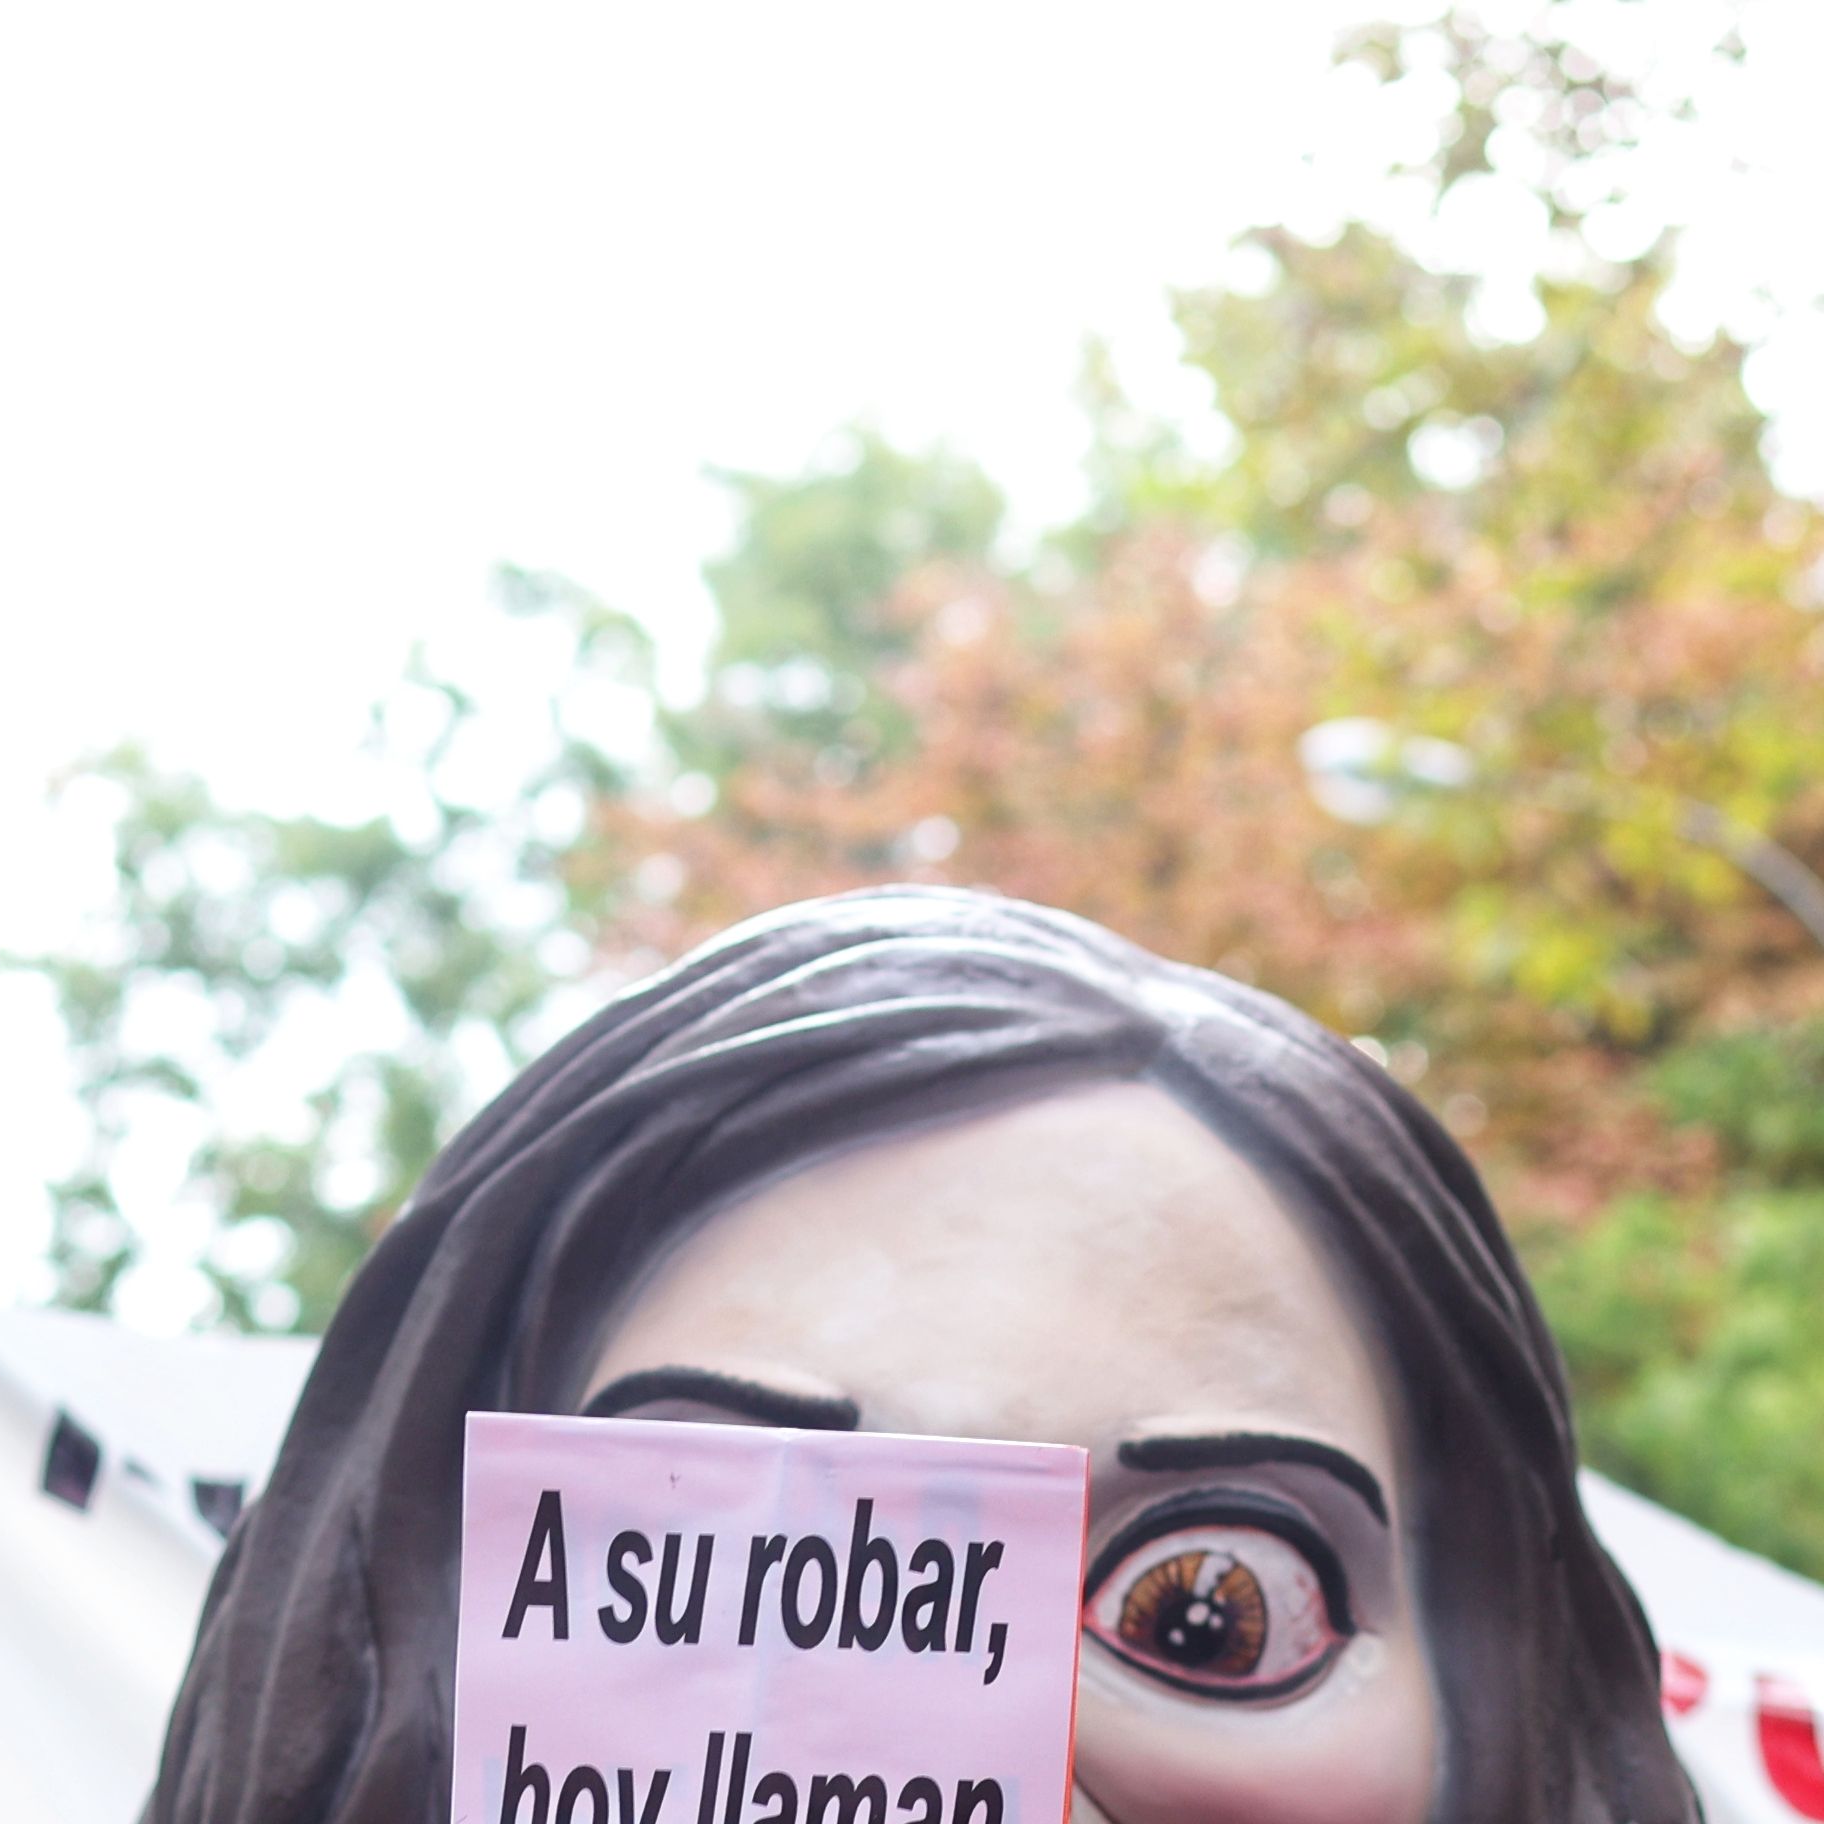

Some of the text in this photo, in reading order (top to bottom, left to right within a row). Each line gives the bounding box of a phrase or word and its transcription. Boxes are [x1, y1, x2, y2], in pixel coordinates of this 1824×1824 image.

[501, 1490, 1010, 1686] A su robar,
